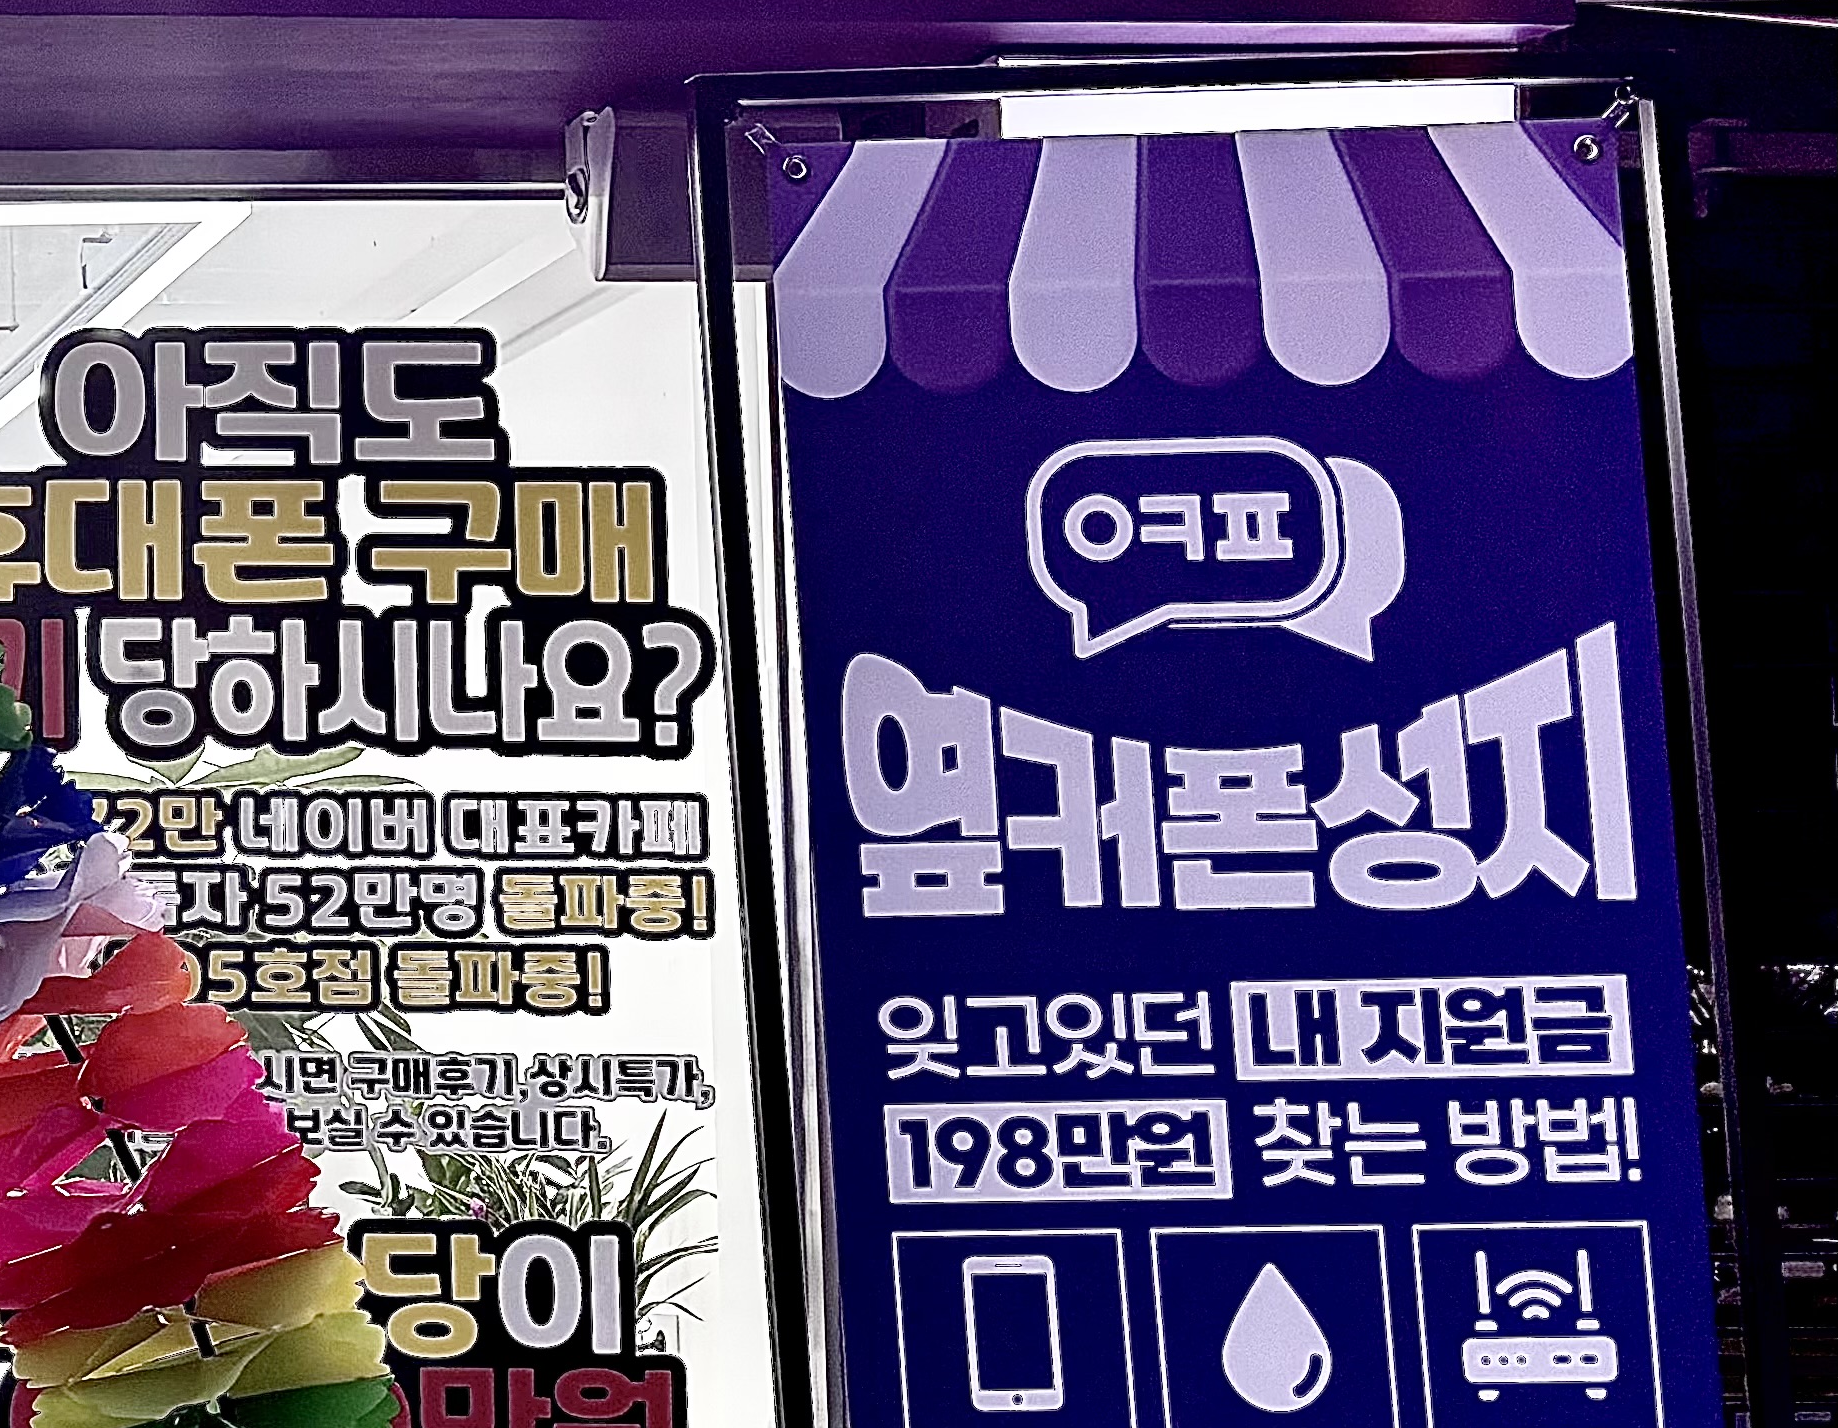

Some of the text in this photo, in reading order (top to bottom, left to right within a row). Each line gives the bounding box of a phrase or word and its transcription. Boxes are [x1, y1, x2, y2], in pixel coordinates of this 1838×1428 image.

[53, 339, 498, 465] 아직도
[364, 479, 656, 605] 구매
[99, 614, 709, 751] 당하시나요?
[841, 620, 1638, 918] 옆커폰성지
[237, 800, 430, 857] 네이버
[452, 799, 704, 859] 대표카페
[258, 871, 478, 931] 52만명
[500, 874, 708, 932] 돌파중!
[396, 952, 604, 1008] 돌파중!
[878, 982, 1615, 1080] 잊고있던 내 지원금
[375, 1109, 419, 1146] 수
[427, 1108, 611, 1150] 있습니다.
[897, 1095, 1643, 1191] 198만원 찾는 방법!
